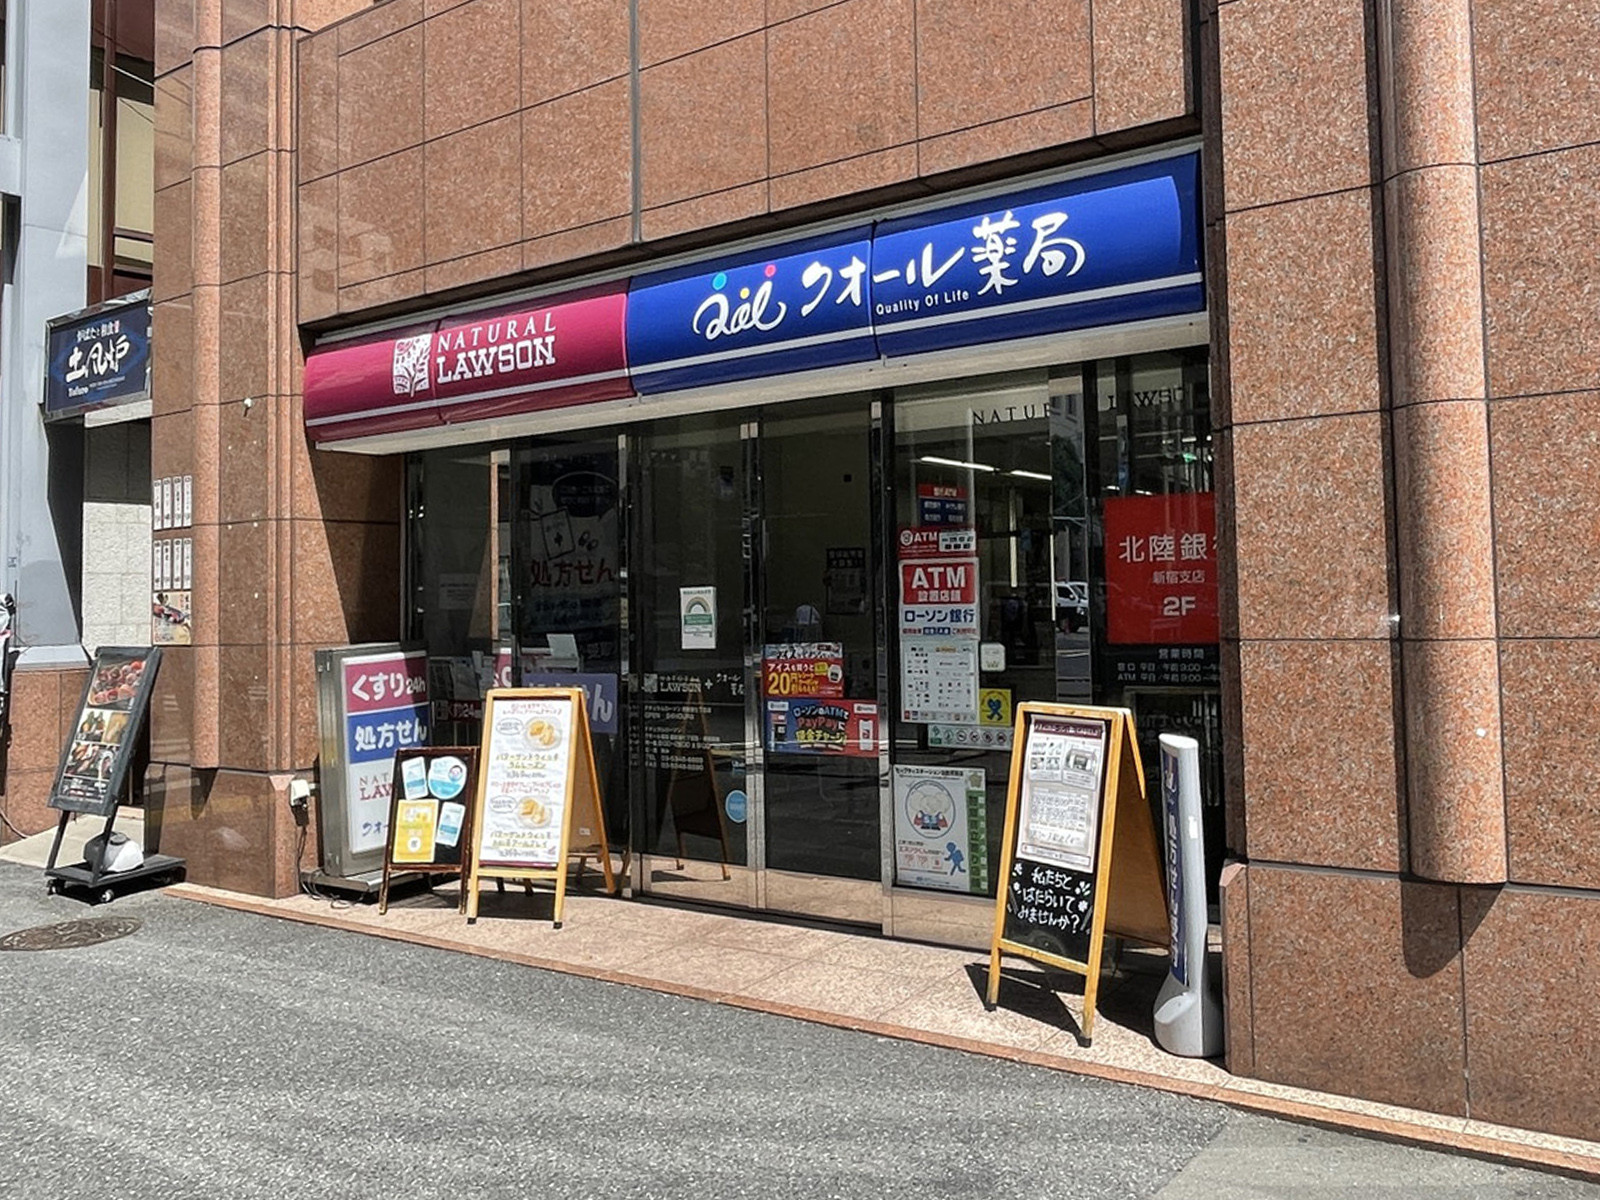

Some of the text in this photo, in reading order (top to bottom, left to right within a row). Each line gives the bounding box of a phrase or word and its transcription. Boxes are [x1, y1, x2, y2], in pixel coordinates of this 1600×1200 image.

[801, 210, 1085, 318] クオール薬局
[875, 289, 970, 316] Quality Of Life
[437, 312, 557, 354] NATURAL
[436, 335, 557, 385] LAWSON
[914, 532, 938, 543] ATM
[1119, 533, 1217, 563] 北陸銀
[530, 558, 615, 588] 処方せん
[911, 567, 966, 589] ATM
[1153, 570, 1206, 584] 新宿支店
[904, 608, 975, 623] ローソン銀行
[1163, 596, 1196, 616] 2F
[352, 672, 426, 702] くすり 24h
[660, 682, 702, 693] LAWSON
[768, 672, 791, 695] 20
[1117, 673, 1136, 682] ATM
[355, 717, 428, 752] 処方せん
[1031, 866, 1072, 891] 私たちと
[1022, 887, 1076, 914] はたらいて
[1017, 905, 1080, 934] みませんか?
